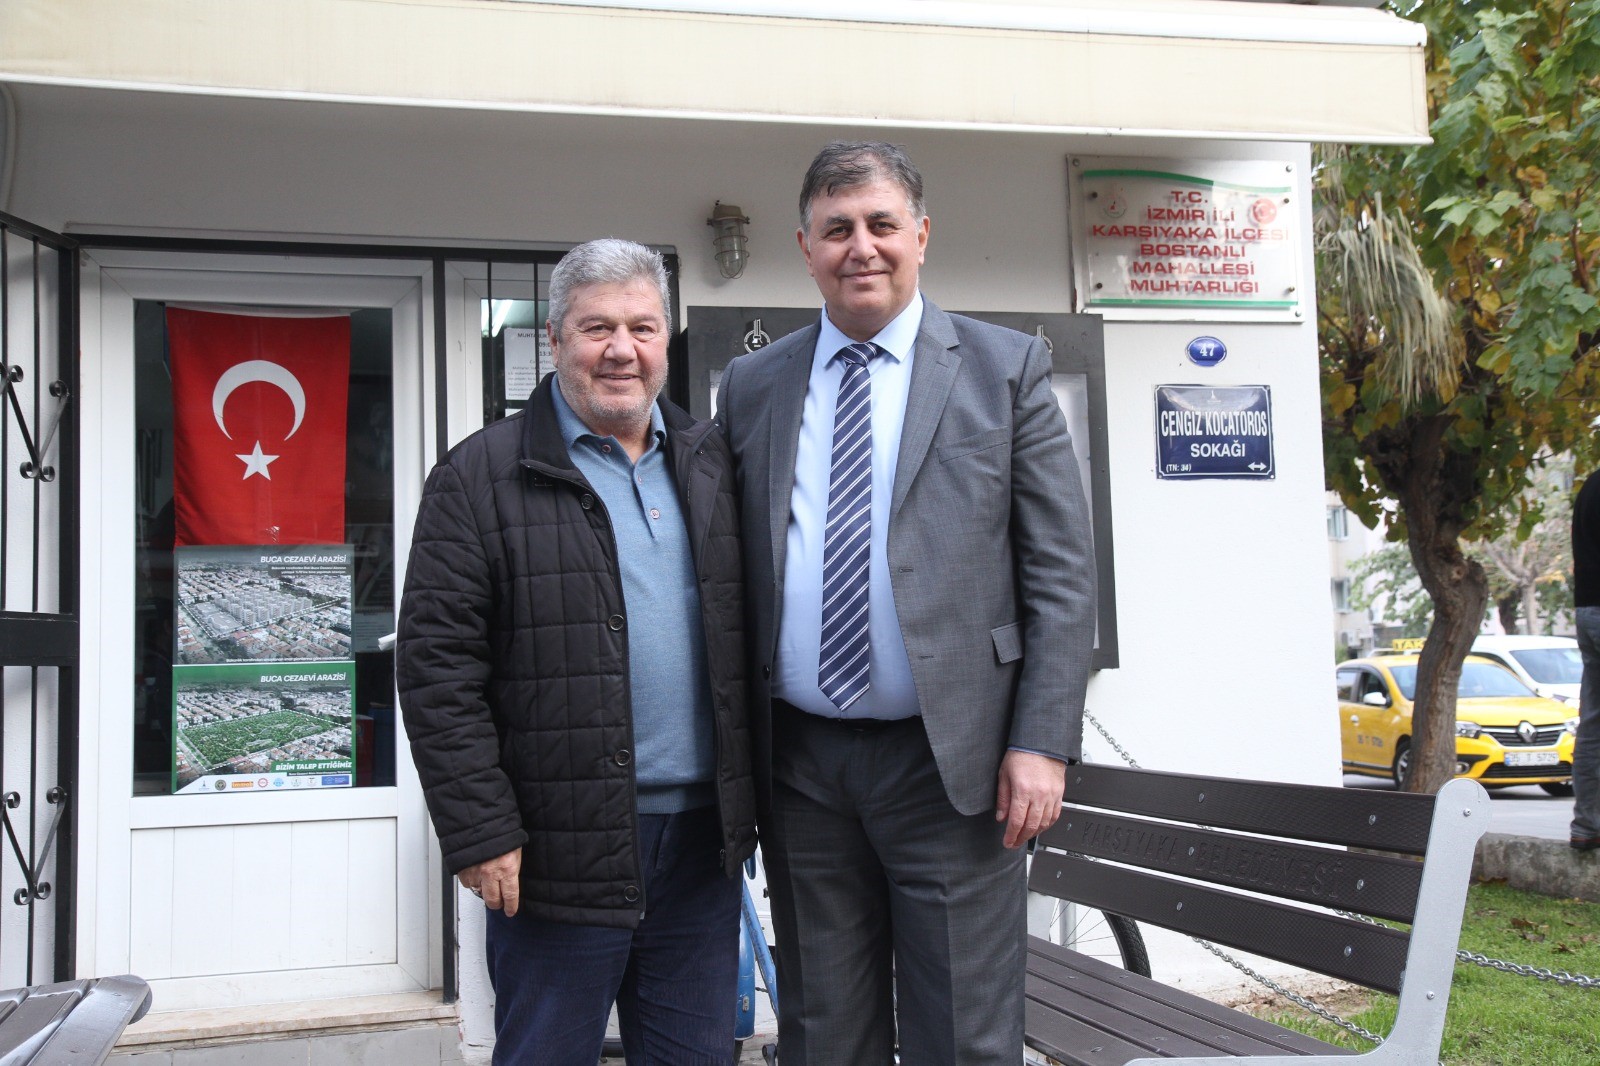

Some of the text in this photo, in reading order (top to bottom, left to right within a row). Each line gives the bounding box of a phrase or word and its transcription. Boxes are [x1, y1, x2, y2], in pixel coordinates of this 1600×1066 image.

[1171, 191, 1208, 204] T.C.
[1148, 206, 1234, 221] İZMİR İLİ
[1092, 225, 1217, 240] KARŞIYAKA
[1140, 244, 1245, 257] BOSTANLI
[1133, 260, 1254, 275] MAHALLESİ
[1130, 279, 1259, 293] MUHTARLIĞI
[1199, 343, 1215, 357] 47
[1205, 410, 1267, 437] KOCATOROS
[1190, 440, 1246, 458] SOKAĞI
[283, 555, 316, 563] CEZAEVİ
[317, 555, 347, 563] ARAZİSİ
[260, 672, 347, 683] BUCA CEZAEVİ ARAZİSİ
[275, 763, 295, 771] BİZİM
[317, 761, 352, 769] ETTİĞİMİZ
